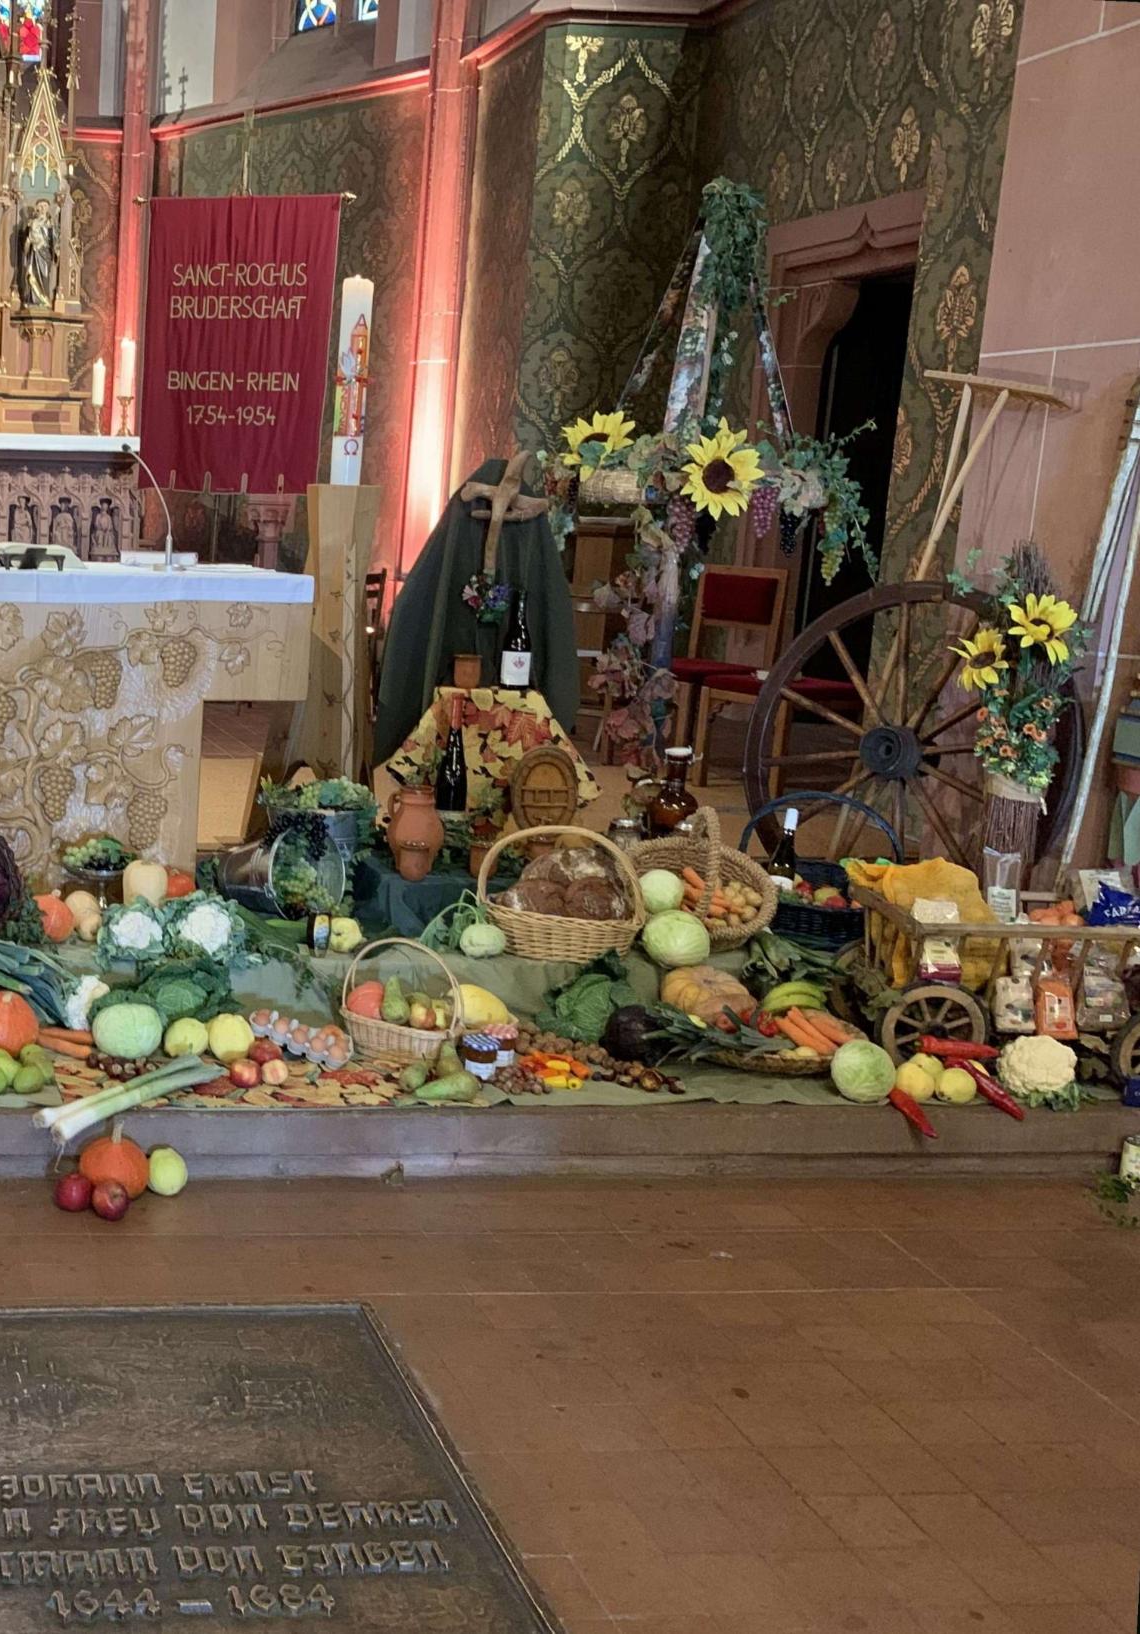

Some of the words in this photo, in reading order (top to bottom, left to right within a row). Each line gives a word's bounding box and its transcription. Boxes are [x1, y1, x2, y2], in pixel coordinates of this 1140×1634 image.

[172, 262, 307, 288] SANCT-ROCHUS
[170, 295, 307, 320] BRUDERSCHAFT
[186, 404, 276, 426] 1754-1954
[0, 1473, 164, 1500] JOHANN
[182, 1470, 317, 1500] ERNST
[276, 1540, 451, 1576] BINGEN
[49, 1588, 162, 1620] 1644
